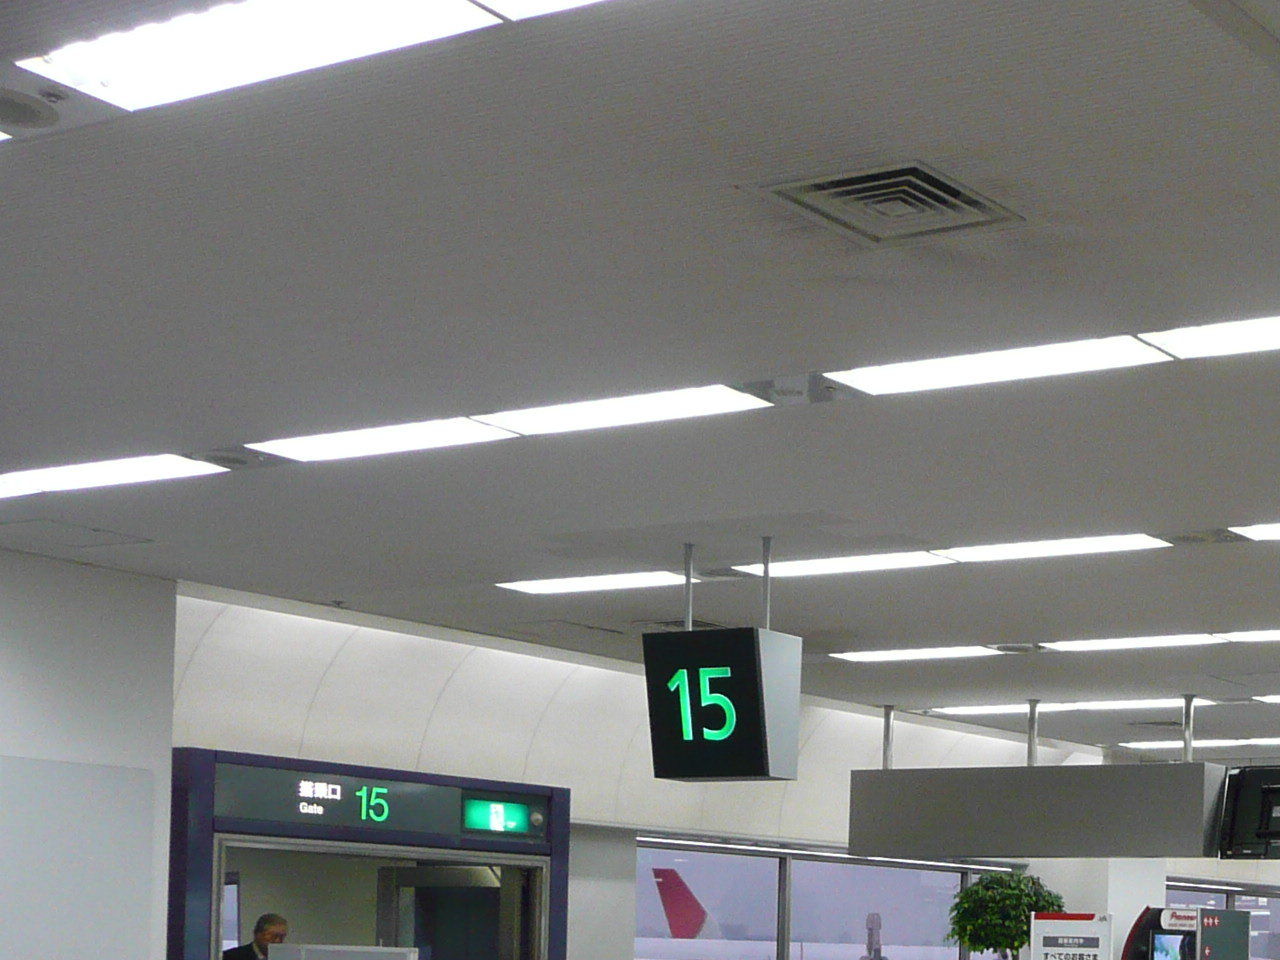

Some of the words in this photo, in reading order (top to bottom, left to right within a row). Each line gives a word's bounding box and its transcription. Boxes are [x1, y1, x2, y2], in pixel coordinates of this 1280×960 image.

[667, 666, 736, 740] 15
[299, 802, 324, 815] Gate
[355, 785, 389, 822] 15
